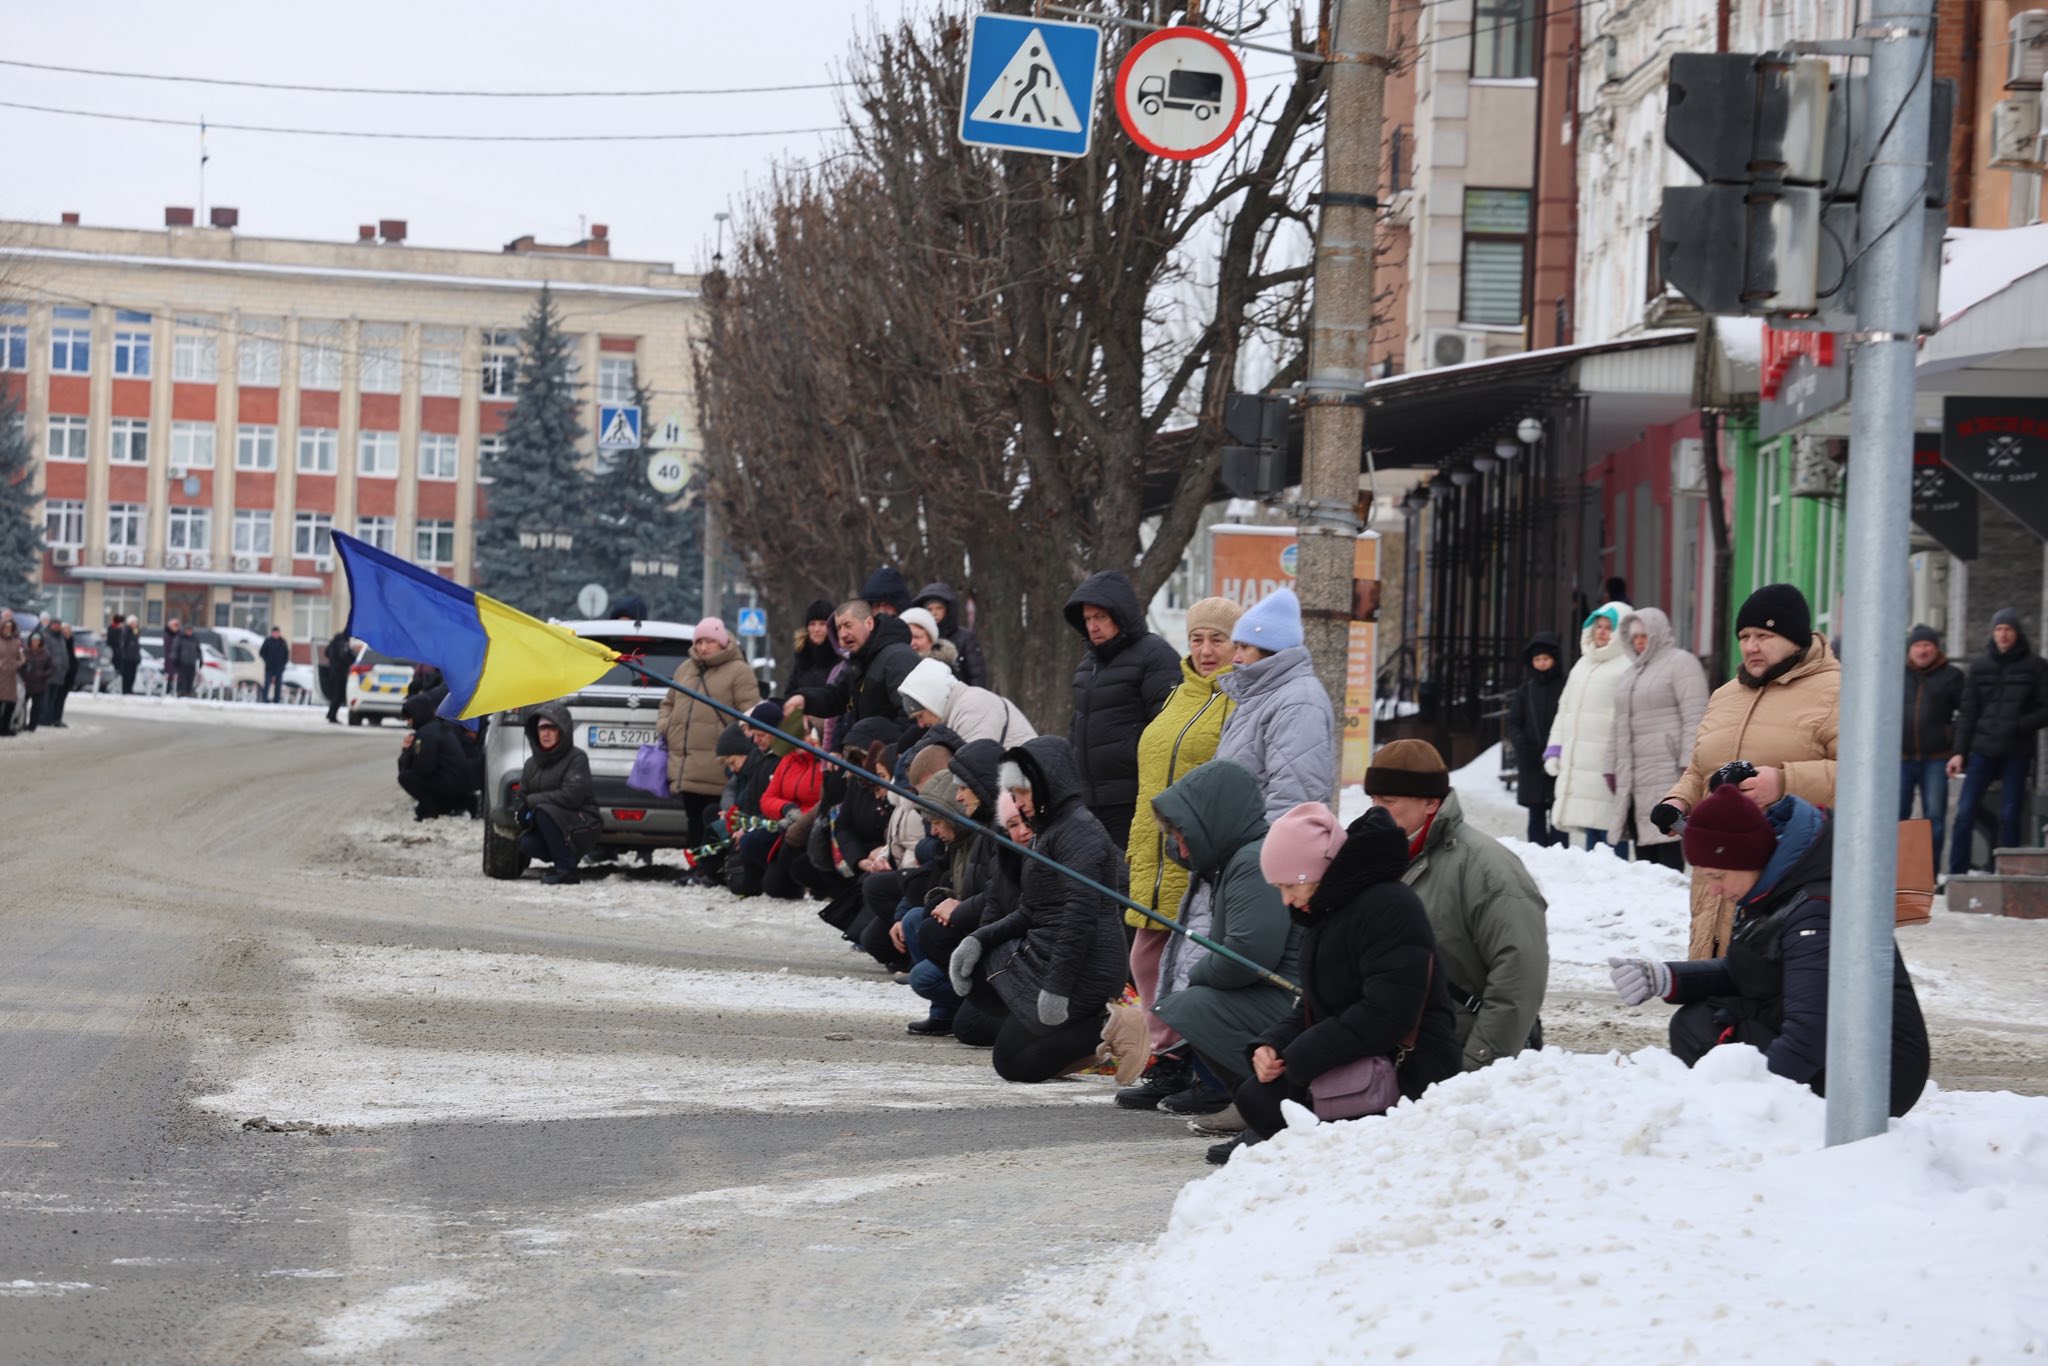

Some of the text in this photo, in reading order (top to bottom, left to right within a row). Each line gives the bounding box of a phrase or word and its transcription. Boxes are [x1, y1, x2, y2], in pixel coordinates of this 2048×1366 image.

[658, 465, 680, 479] 40
[598, 730, 616, 742] CA
[620, 731, 650, 743] 5270
